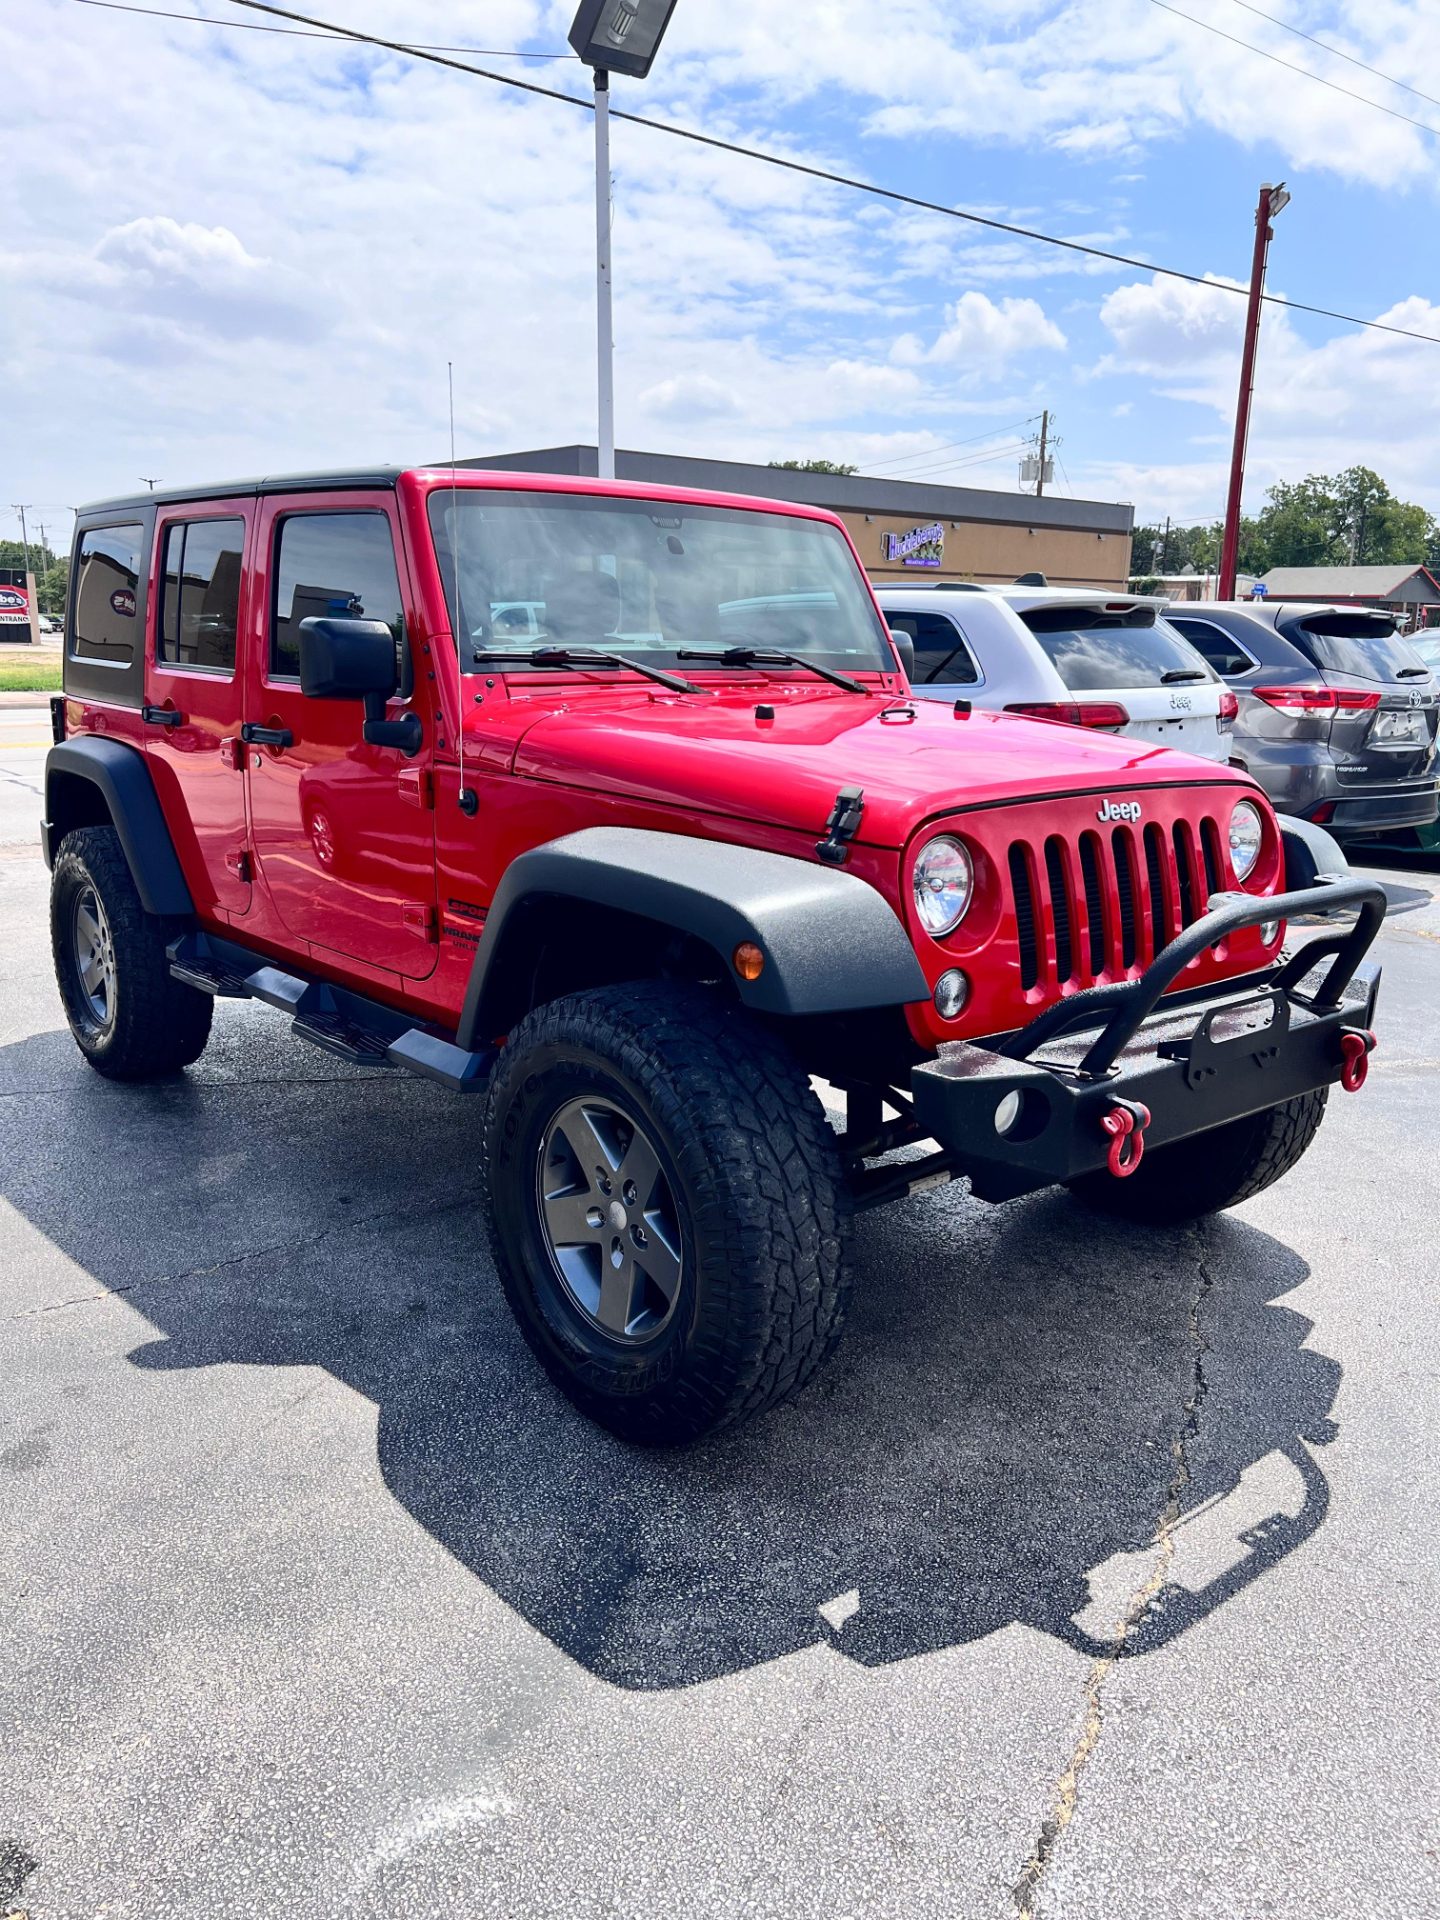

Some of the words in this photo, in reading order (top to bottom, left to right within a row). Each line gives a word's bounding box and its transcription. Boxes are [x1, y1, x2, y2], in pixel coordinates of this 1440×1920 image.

[888, 522, 944, 560] Huckleberry's
[0, 594, 22, 604] be's
[1170, 694, 1191, 711] Jeep
[1097, 798, 1142, 823] Jeep
[450, 901, 488, 918] SPOR
[443, 927, 481, 943] WRANG
